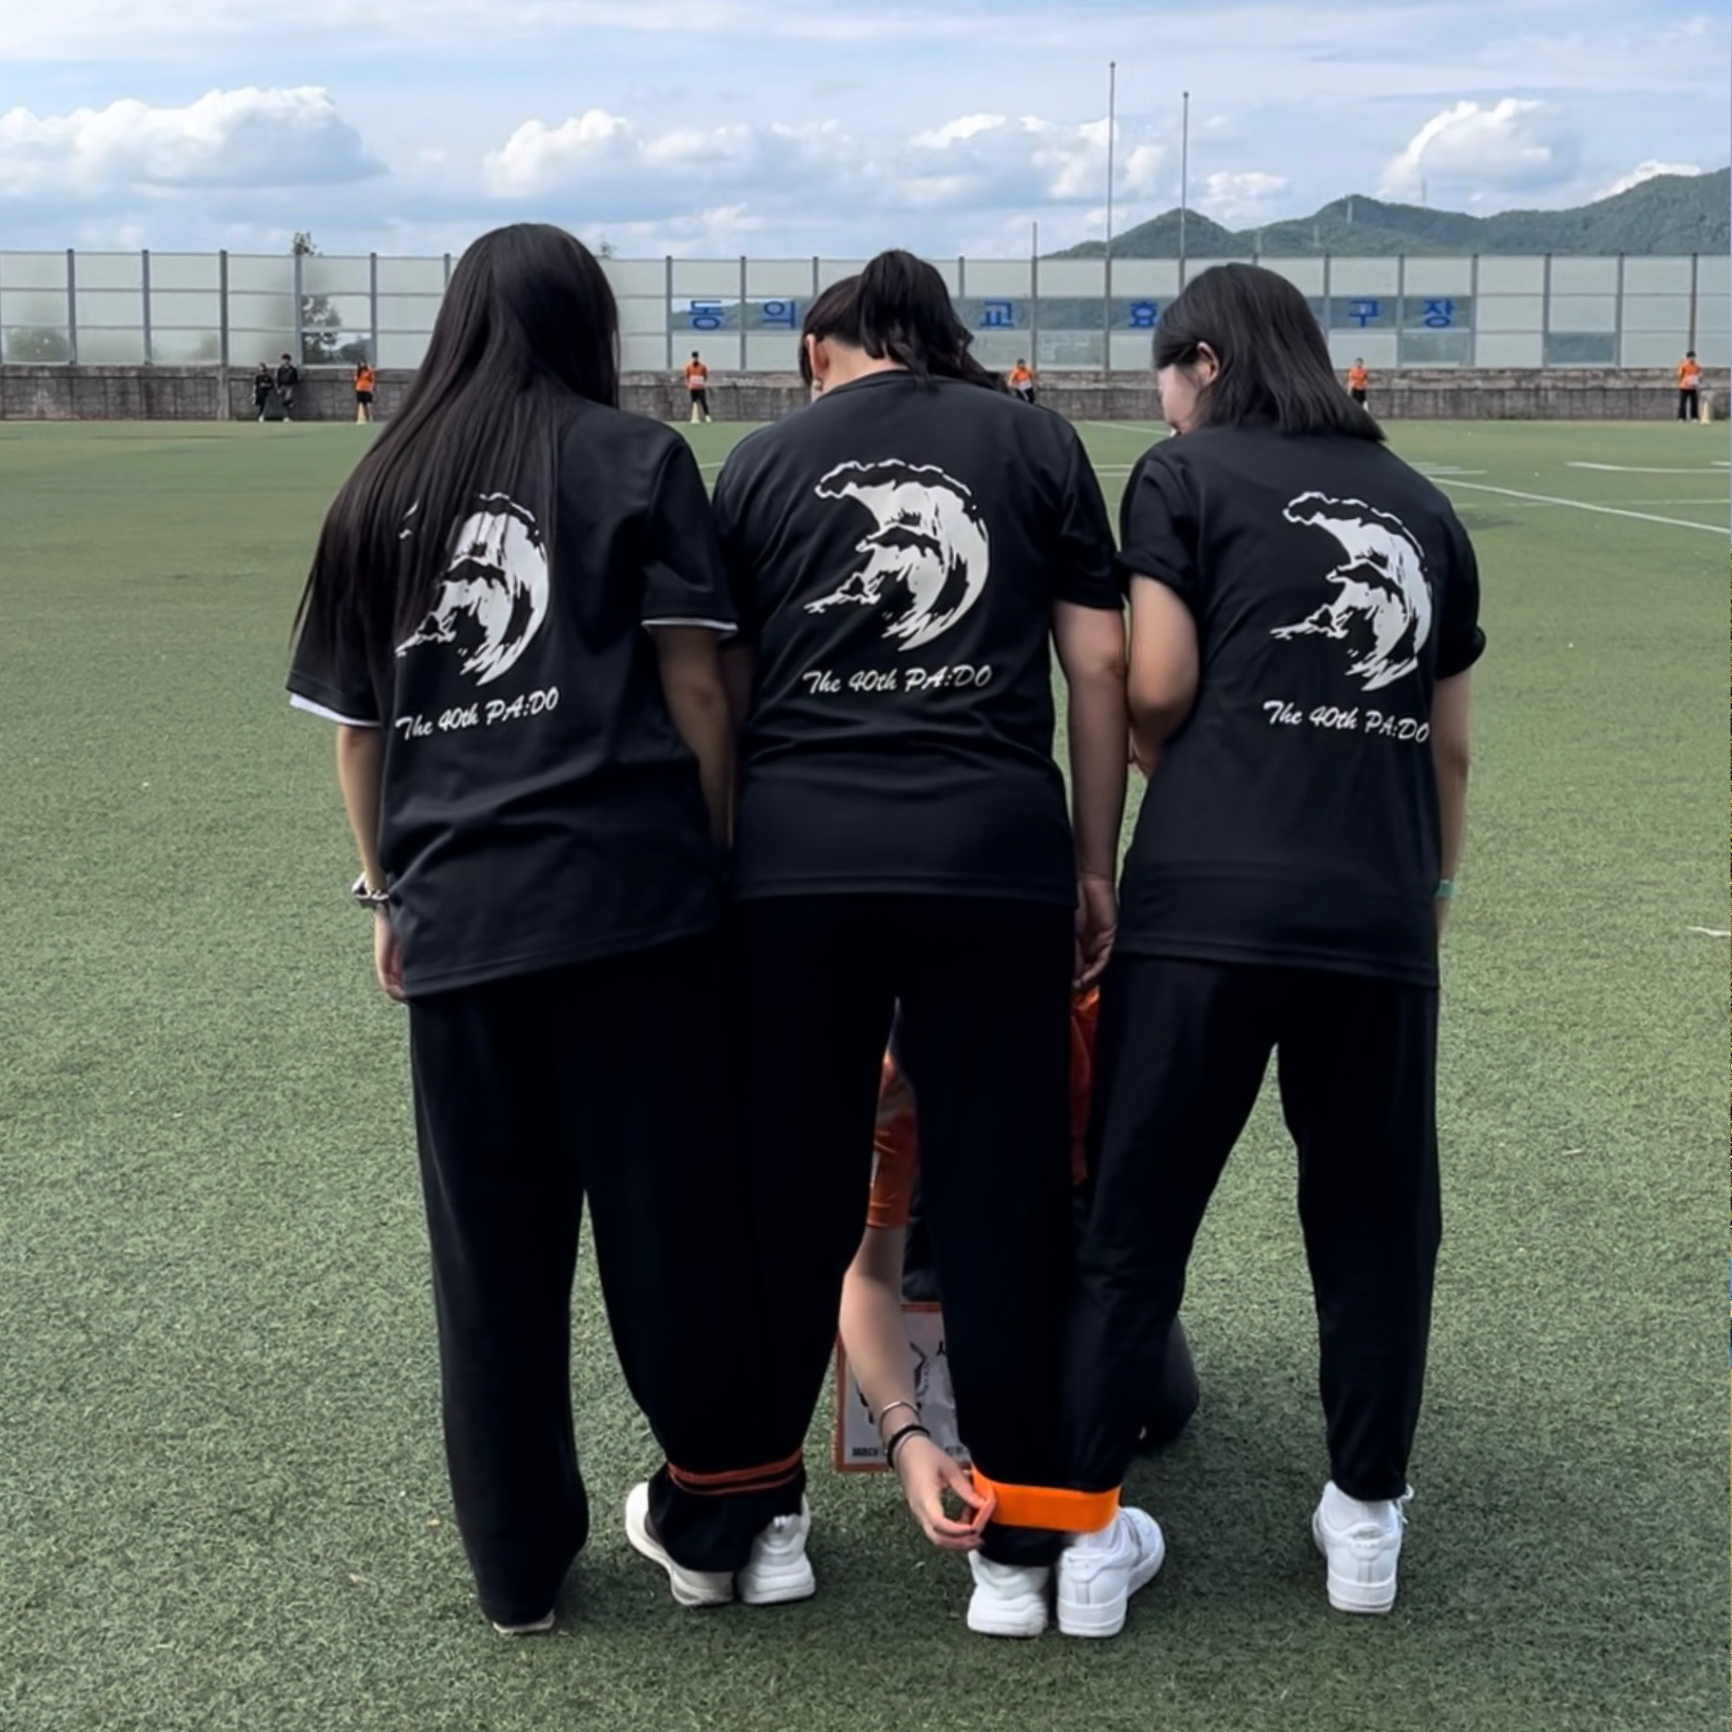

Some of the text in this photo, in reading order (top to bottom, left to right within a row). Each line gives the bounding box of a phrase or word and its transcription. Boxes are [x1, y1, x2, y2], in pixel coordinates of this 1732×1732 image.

[802, 664, 992, 694] The 40th PA:DO
[394, 685, 559, 741] The 40th PA:DO
[1262, 699, 1430, 744] The 40th PA:DO
